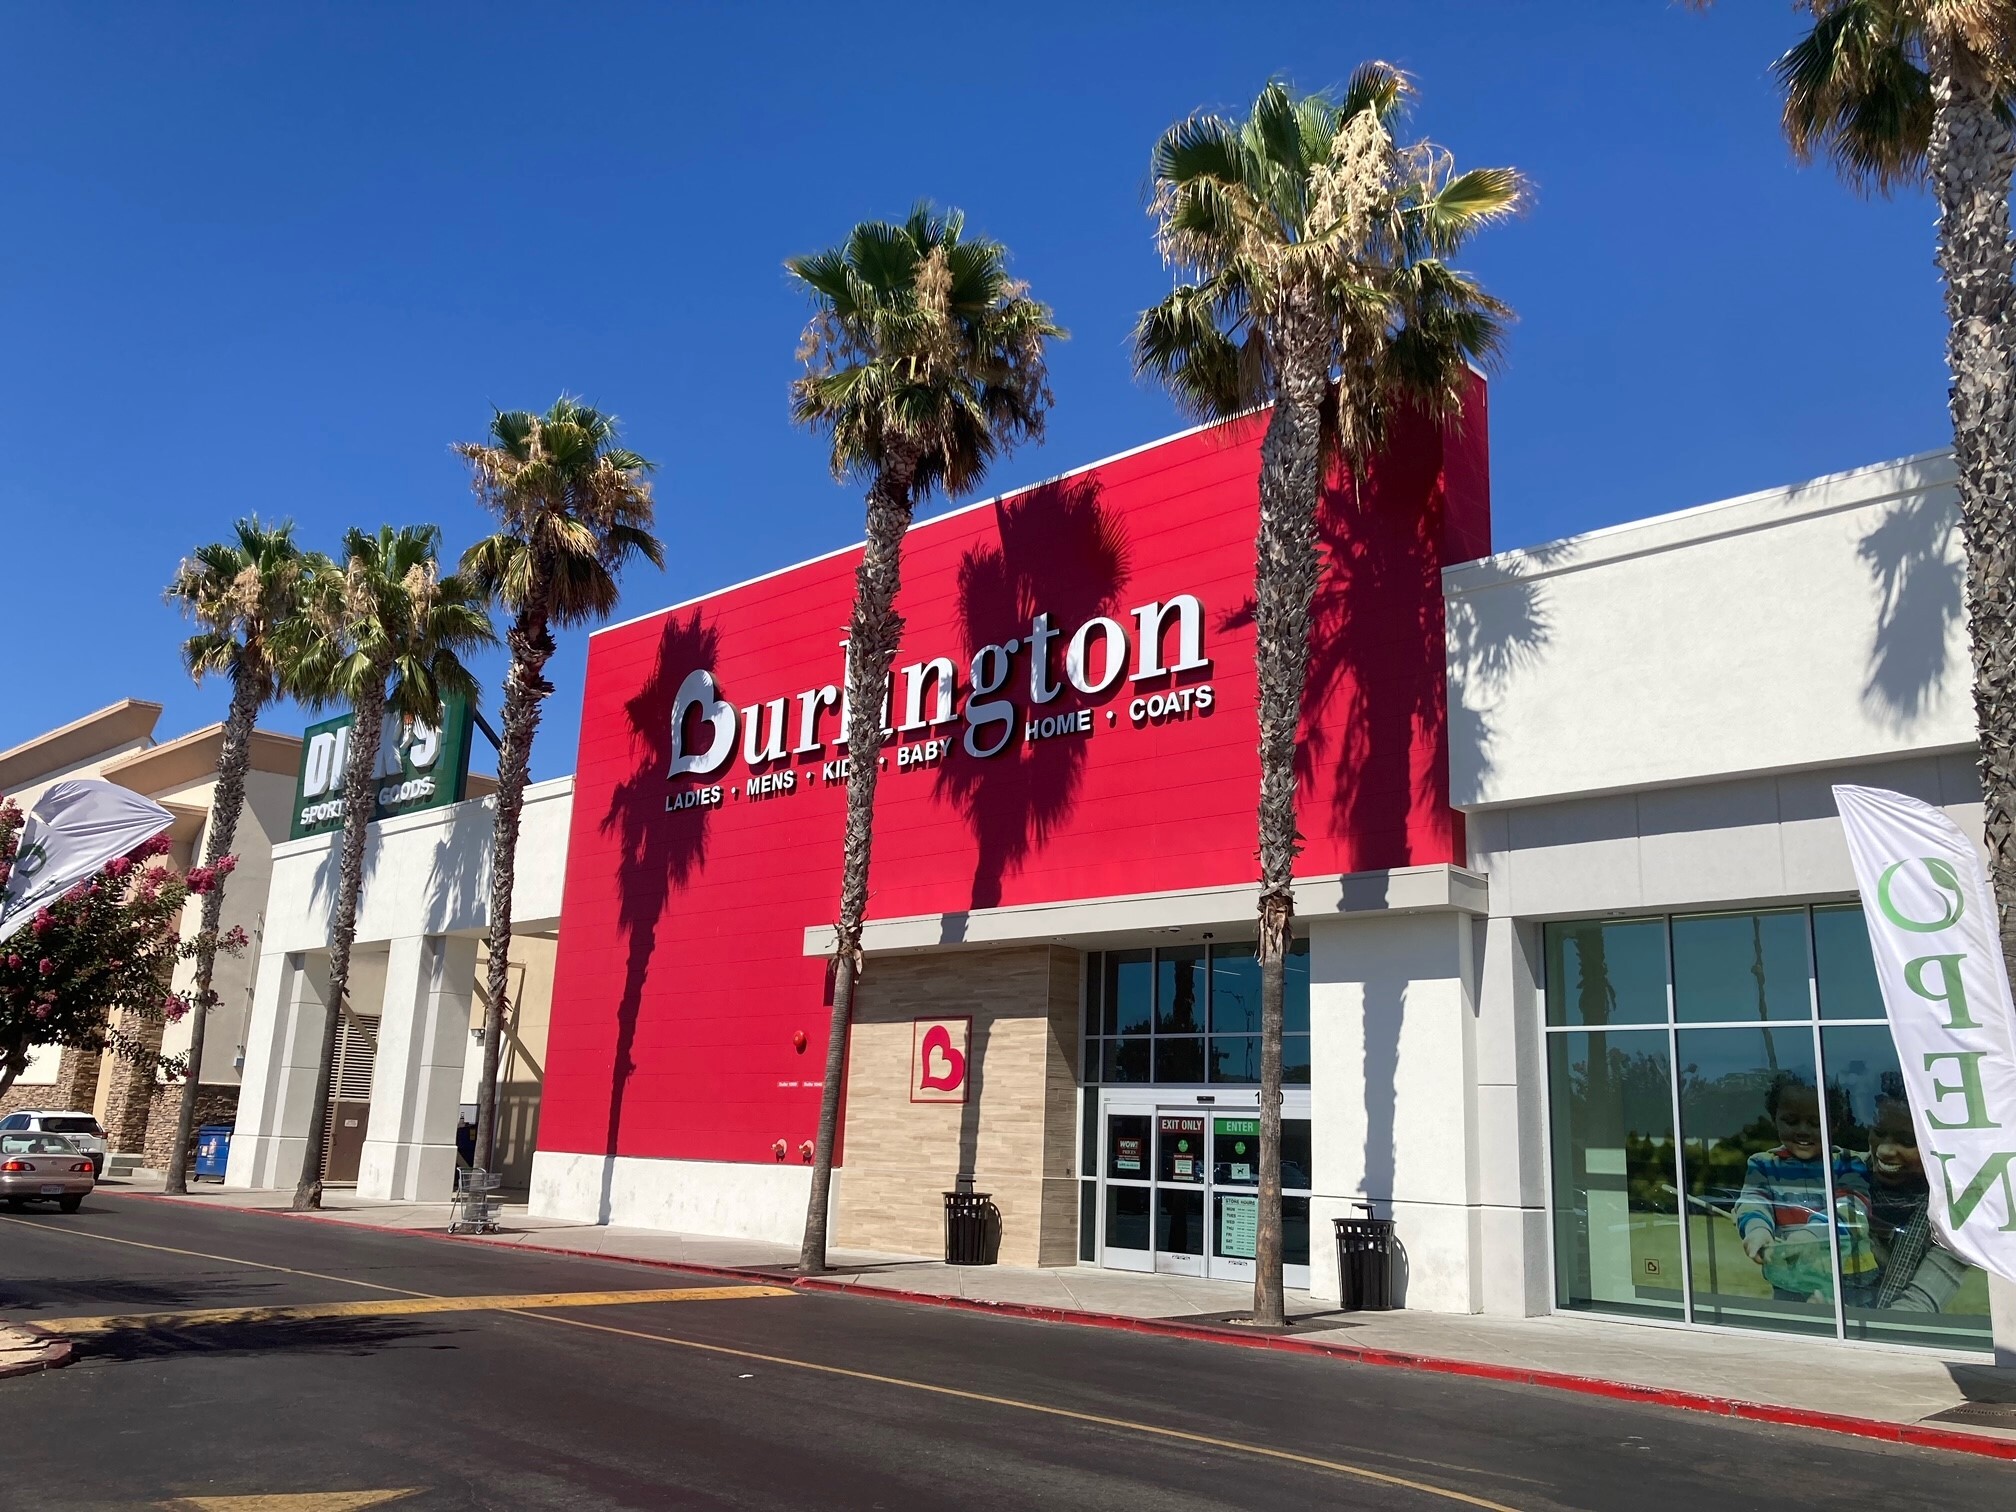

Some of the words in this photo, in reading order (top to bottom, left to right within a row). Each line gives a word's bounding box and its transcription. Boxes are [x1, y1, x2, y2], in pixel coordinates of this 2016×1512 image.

[303, 700, 444, 798] DIK'S
[665, 785, 721, 813] LADIES
[746, 769, 795, 798] MENS
[822, 758, 851, 781] KID
[896, 736, 954, 767] BABY
[1024, 709, 1091, 742] HOME
[1128, 686, 1213, 722] COATS
[299, 798, 347, 826] SPORT
[379, 776, 436, 807] GOODS
[1161, 1119, 1180, 1130] EXIT
[1181, 1120, 1202, 1131] ONLY
[1226, 1121, 1254, 1132] ENTER
